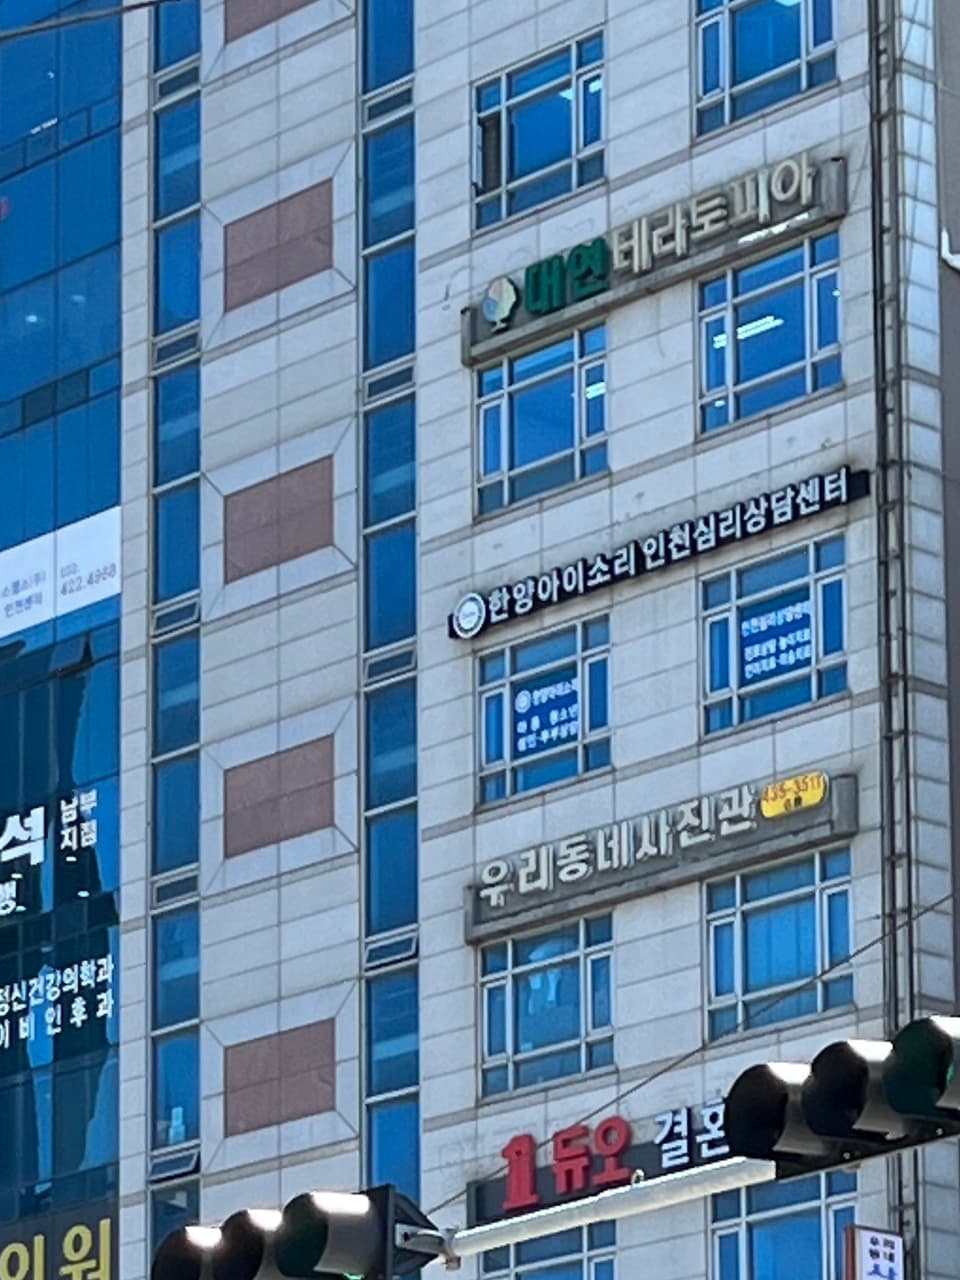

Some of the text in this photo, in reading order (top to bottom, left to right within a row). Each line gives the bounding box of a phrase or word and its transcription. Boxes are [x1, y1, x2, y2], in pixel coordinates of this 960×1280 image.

[487, 468, 848, 623] 한양아이소리 인천심리상담센터
[480, 785, 756, 907] 우리동네사진관
[552, 1116, 634, 1194] 듀오
